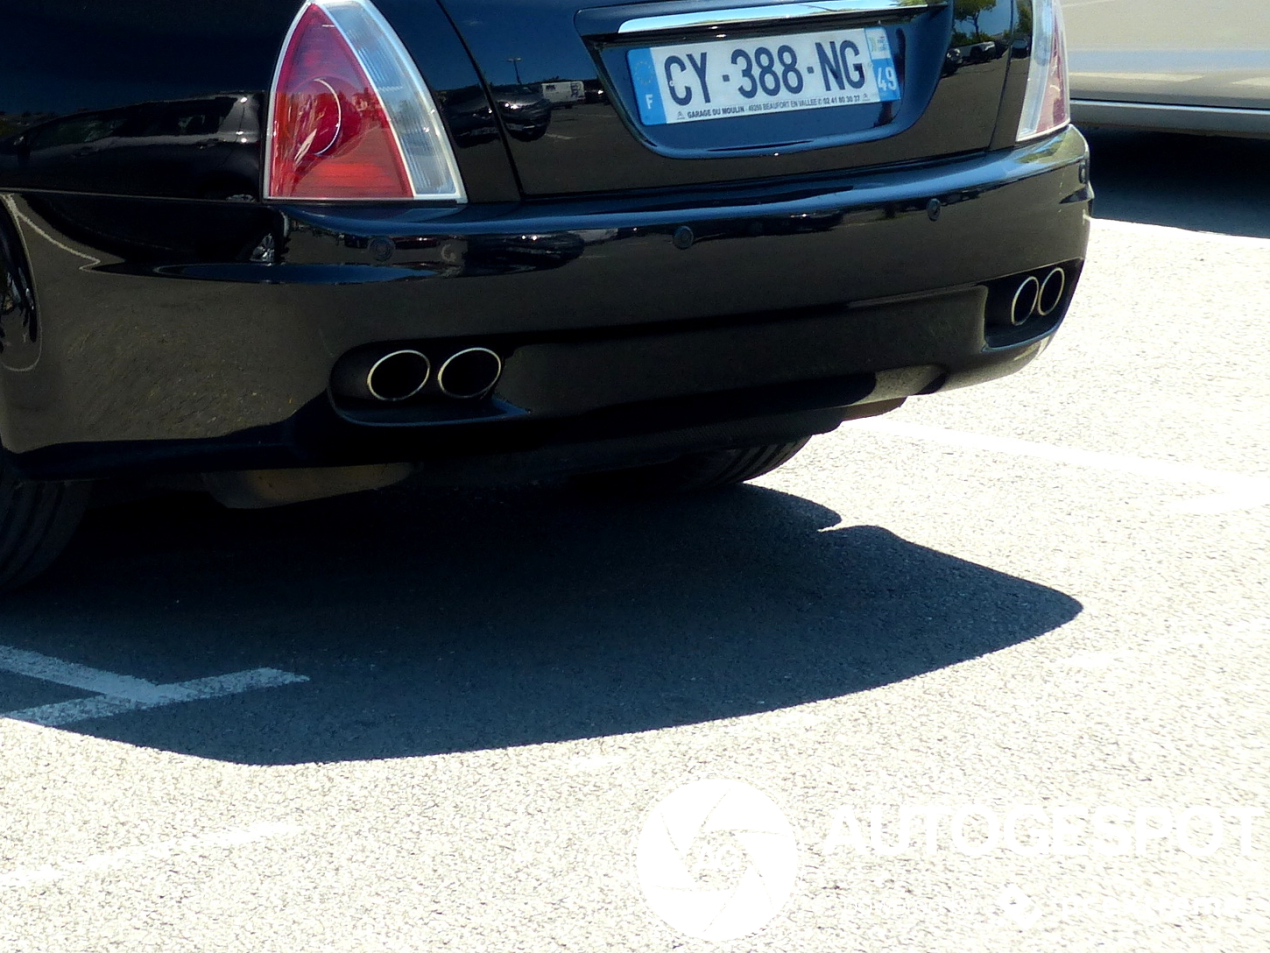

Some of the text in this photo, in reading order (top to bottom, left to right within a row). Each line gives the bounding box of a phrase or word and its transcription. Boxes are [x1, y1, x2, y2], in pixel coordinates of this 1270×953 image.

[664, 40, 866, 106] CY-388-NG
[877, 66, 897, 91] 49
[645, 94, 654, 109] F
[687, 109, 711, 119] GARAGE
[721, 106, 745, 115] MOULIN
